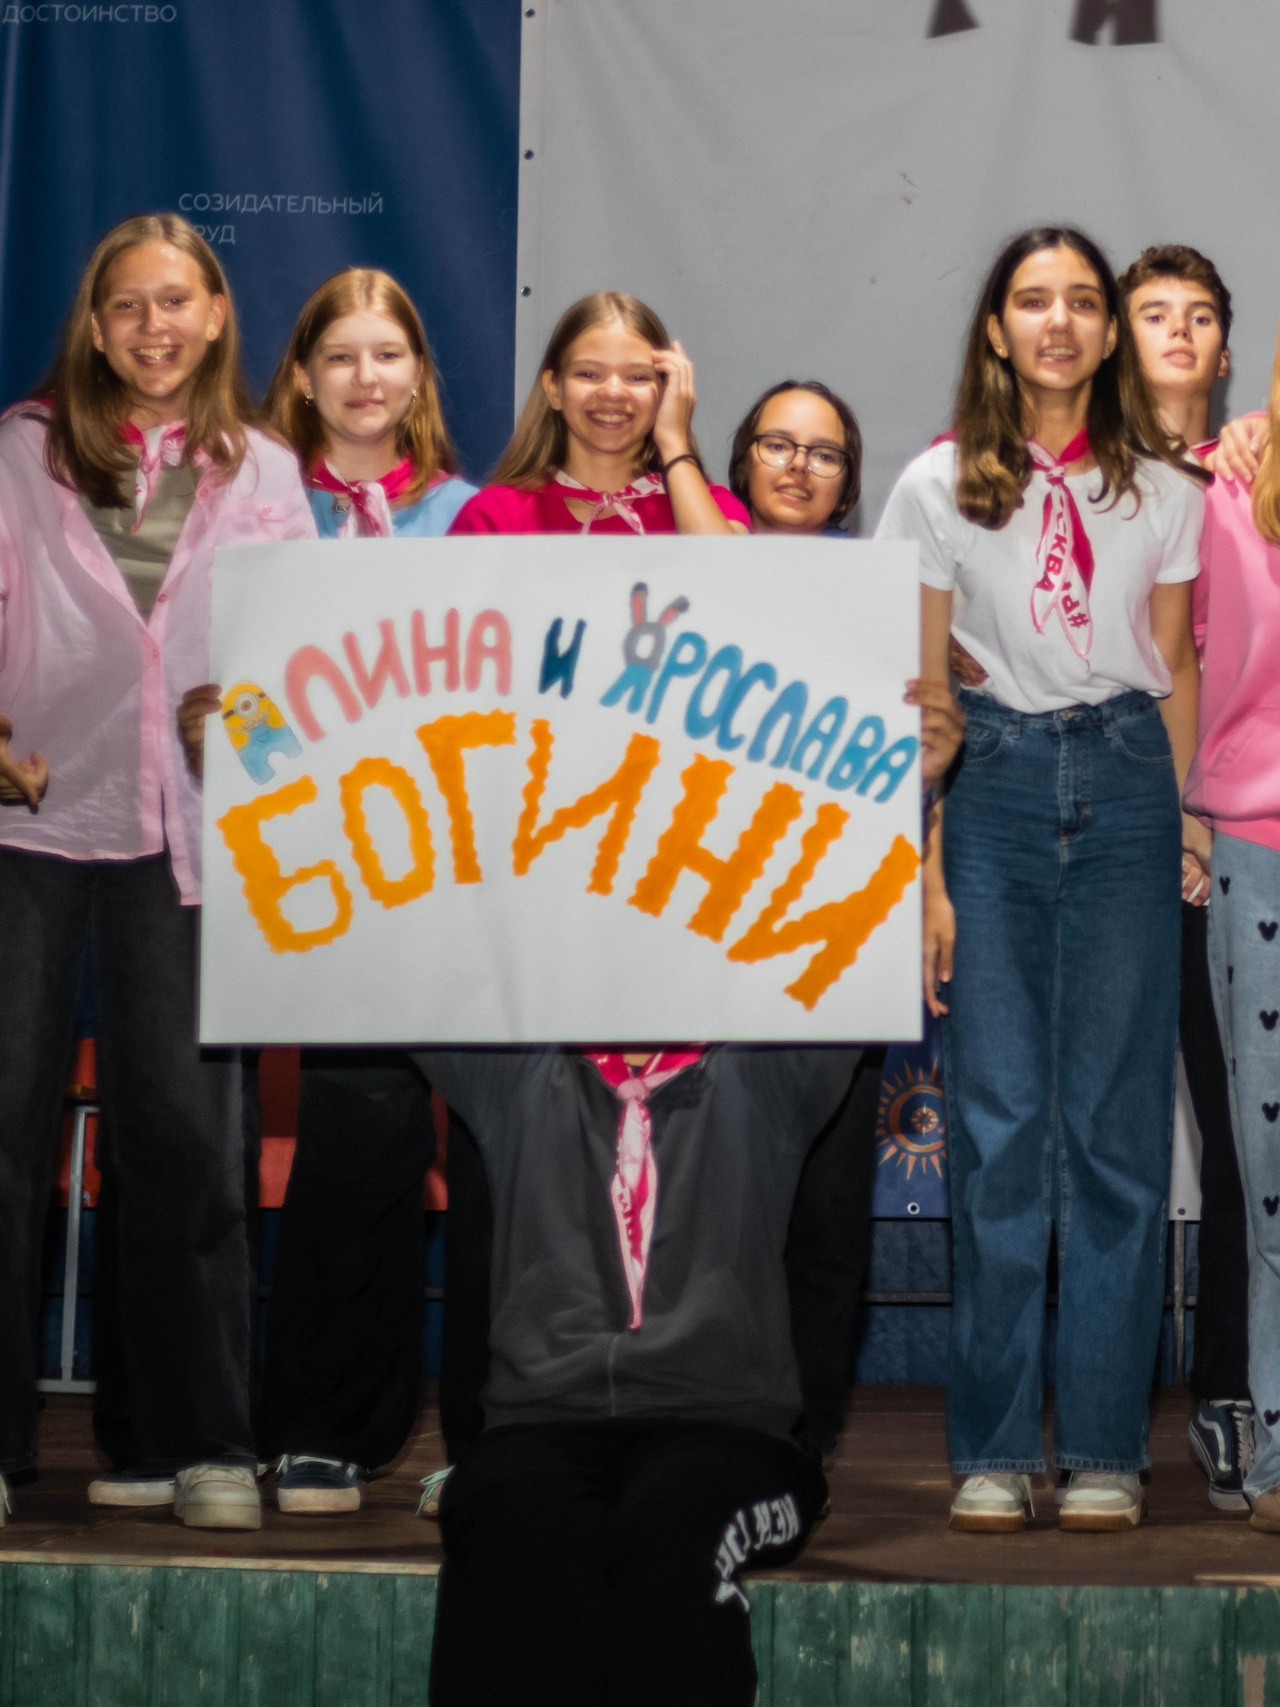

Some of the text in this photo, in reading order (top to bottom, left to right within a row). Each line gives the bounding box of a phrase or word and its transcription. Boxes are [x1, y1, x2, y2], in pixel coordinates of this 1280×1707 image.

[2, 4, 178, 24] ДОСТОИНСТВО
[177, 192, 384, 215] СОЗИДАТЕЛЬНЫЙ
[190, 224, 236, 245] РУД
[538, 617, 587, 698] И
[600, 582, 919, 803] ЯРОСЛАВА
[216, 709, 921, 1011] БОГИНИ
